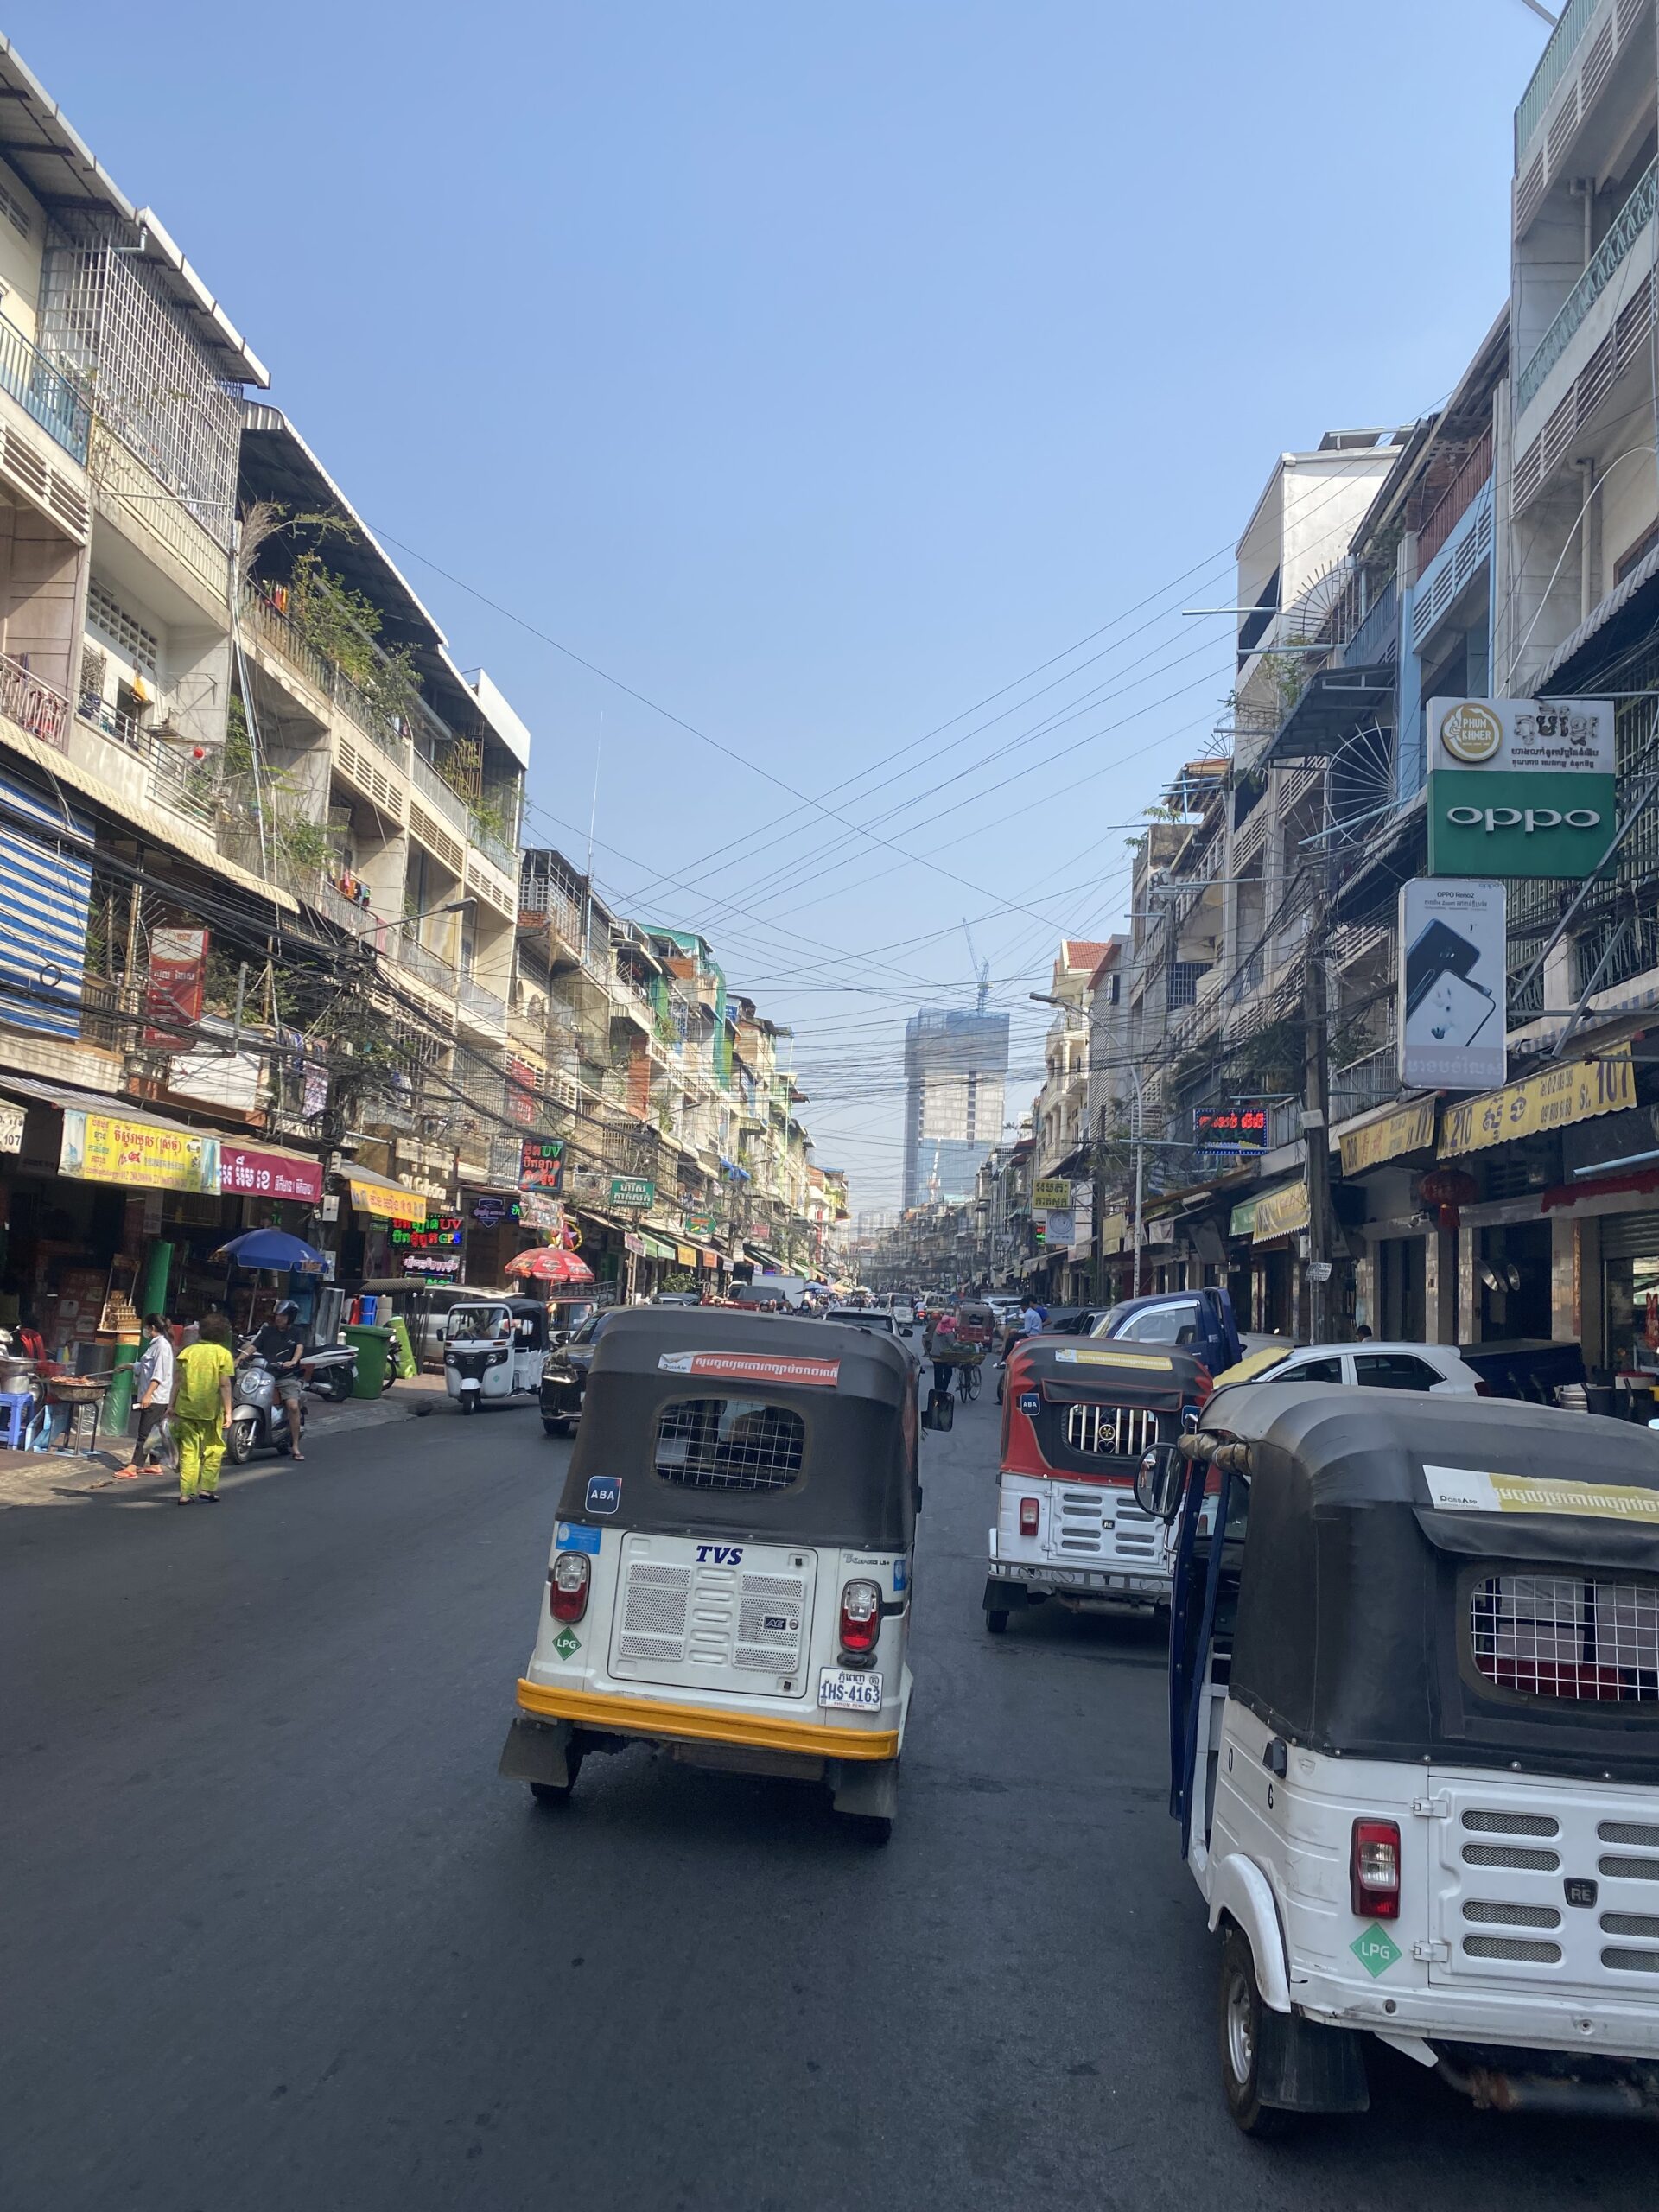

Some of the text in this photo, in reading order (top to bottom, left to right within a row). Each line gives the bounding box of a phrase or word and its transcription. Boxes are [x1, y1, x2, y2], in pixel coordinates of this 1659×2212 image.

[1462, 718, 1487, 728] PHUM
[1462, 730, 1491, 741] KHMER
[4, 1135, 21, 1147] 107
[542, 1146, 562, 1158] UV
[613, 1192, 651, 1202] កាត់សក់
[439, 1218, 463, 1230] UV
[439, 1230, 461, 1244] GPS
[590, 1490, 614, 1501] ABA
[696, 1545, 744, 1566] TVS
[557, 1638, 577, 1649] LPG
[838, 1670, 865, 1686] ភ្នំពេញ
[820, 1683, 880, 1704] 1HS-4163
[1571, 1887, 1591, 1901] RE
[1361, 1942, 1390, 1960] LPG
